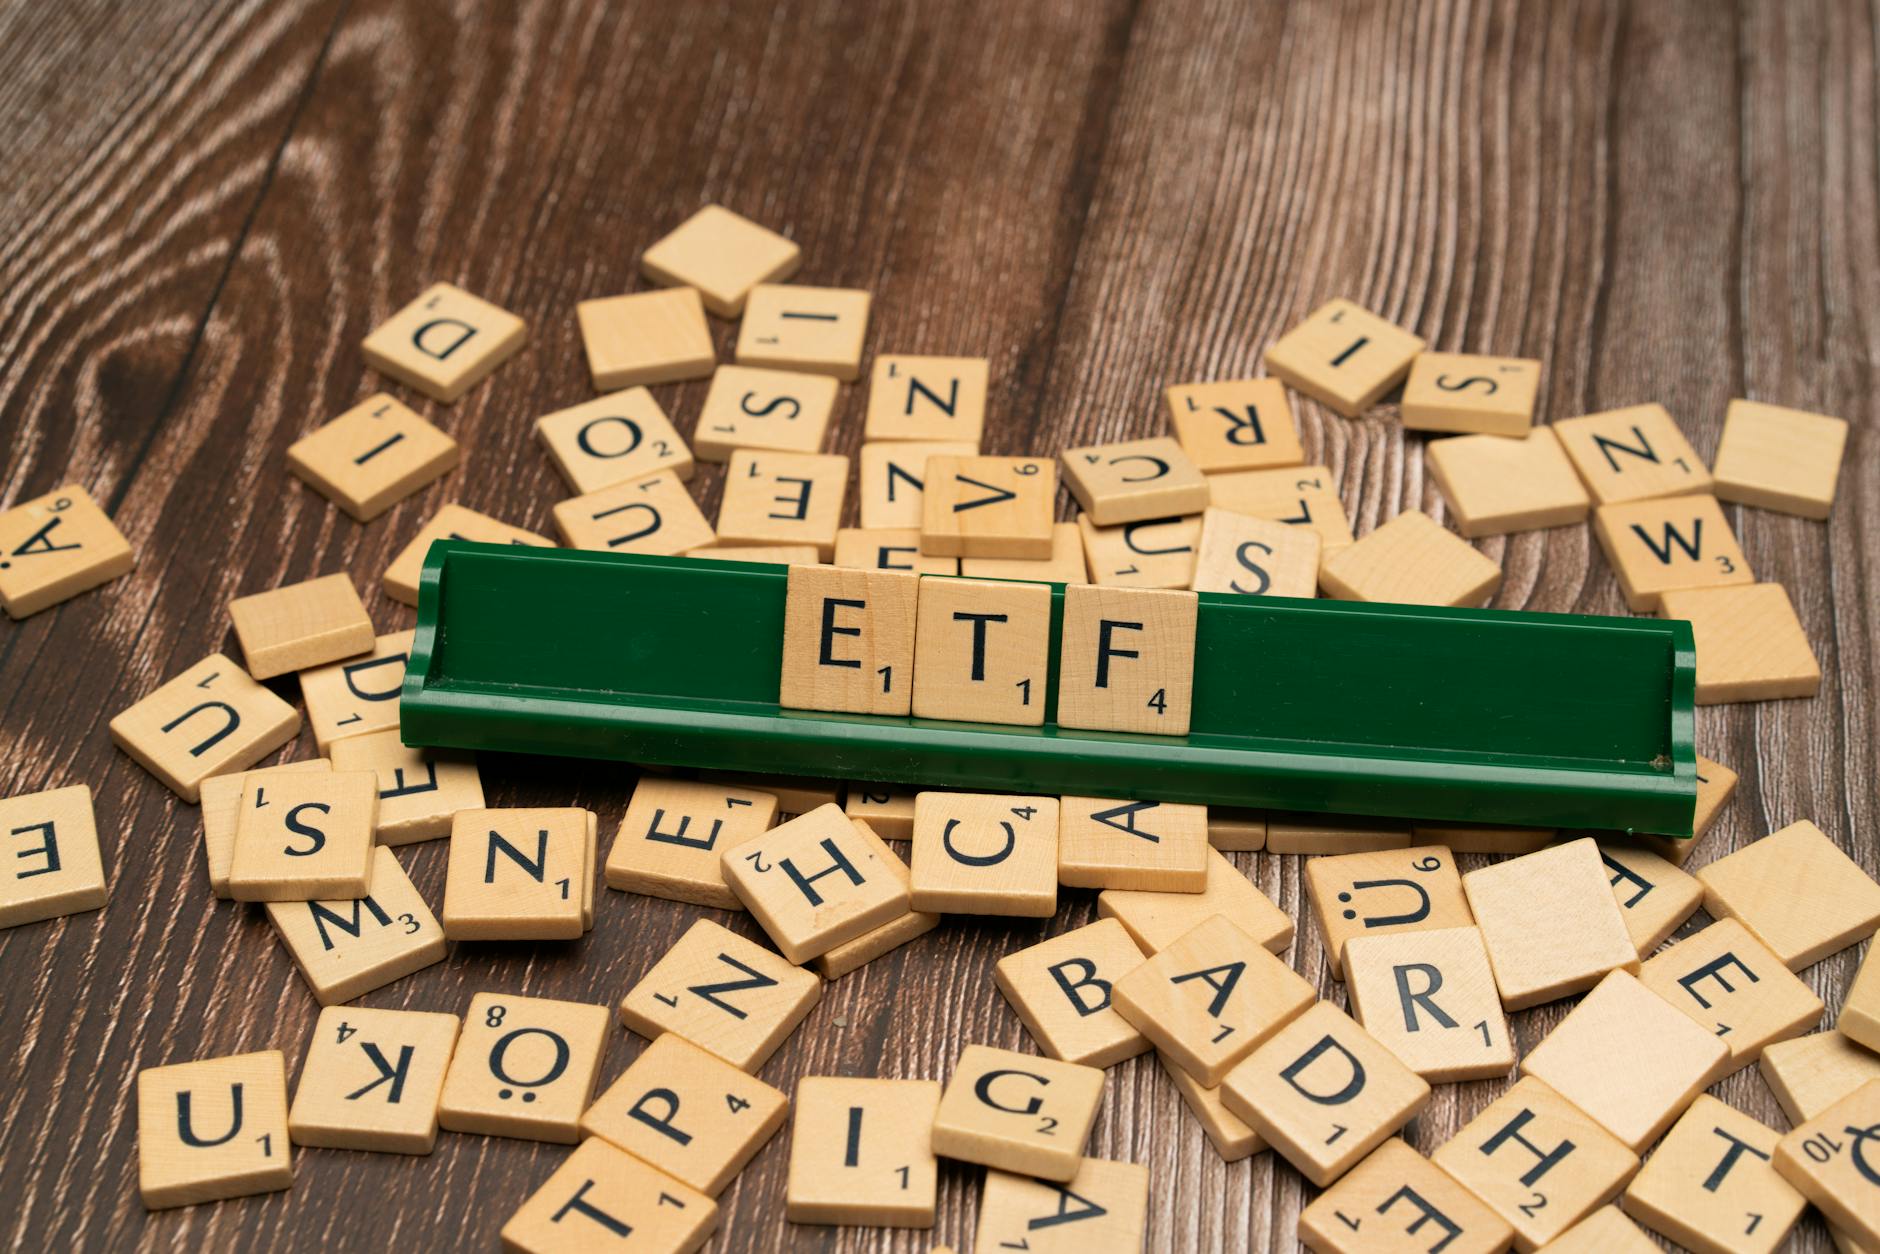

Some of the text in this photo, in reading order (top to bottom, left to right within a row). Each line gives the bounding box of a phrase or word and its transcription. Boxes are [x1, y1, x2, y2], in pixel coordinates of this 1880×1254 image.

[412, 320, 477, 360] D
[1331, 338, 1368, 367] I
[741, 392, 800, 419] S
[889, 363, 959, 417] N 1
[1436, 376, 1498, 394] S
[354, 405, 404, 465] I 1
[577, 417, 672, 458] O 2
[1186, 397, 1266, 445] R 1
[1110, 457, 1170, 482] C
[1593, 427, 1688, 474] N 1
[46, 497, 73, 513] 6
[592, 480, 661, 547] U 1
[749, 462, 812, 520] E 1
[953, 464, 1039, 512] V 6
[1297, 479, 1321, 490] 2
[1124, 517, 1192, 555] U
[1631, 519, 1735, 573] W 3
[1230, 541, 1273, 595] S
[161, 673, 240, 757] U 1
[337, 652, 409, 726] D 1
[878, 666, 891, 693] 1
[1016, 679, 1030, 705] 1
[1148, 689, 1167, 714] 4
[11, 821, 61, 879] E
[256, 788, 330, 856] S 1
[645, 797, 752, 851] E 1
[943, 805, 1037, 866] C 4
[1090, 800, 1160, 843] A
[485, 830, 569, 899] N 1
[745, 838, 866, 907] H 2
[1337, 856, 1440, 928] Ü 6
[307, 895, 420, 951] M 3
[653, 953, 778, 1020] N 1
[1048, 958, 1112, 1017] B
[1170, 962, 1246, 1044] A 1
[1393, 963, 1492, 1047] R 1
[1677, 952, 1760, 1009] E
[337, 1022, 414, 1103] K 4
[485, 1005, 570, 1102] Ö 8
[628, 1088, 750, 1146] P 4
[975, 1070, 1058, 1135] G 2
[1279, 1035, 1366, 1145] D 1
[176, 1083, 271, 1157] U 1
[845, 1107, 909, 1189] I 1
[1802, 1133, 1842, 1163] 10
[1479, 1108, 1576, 1218] H 2
[1703, 1127, 1770, 1235] T 1
[551, 1180, 685, 1237] T 1
[1000, 1177, 1107, 1250] A 1
[1334, 1185, 1463, 1254] E 1
